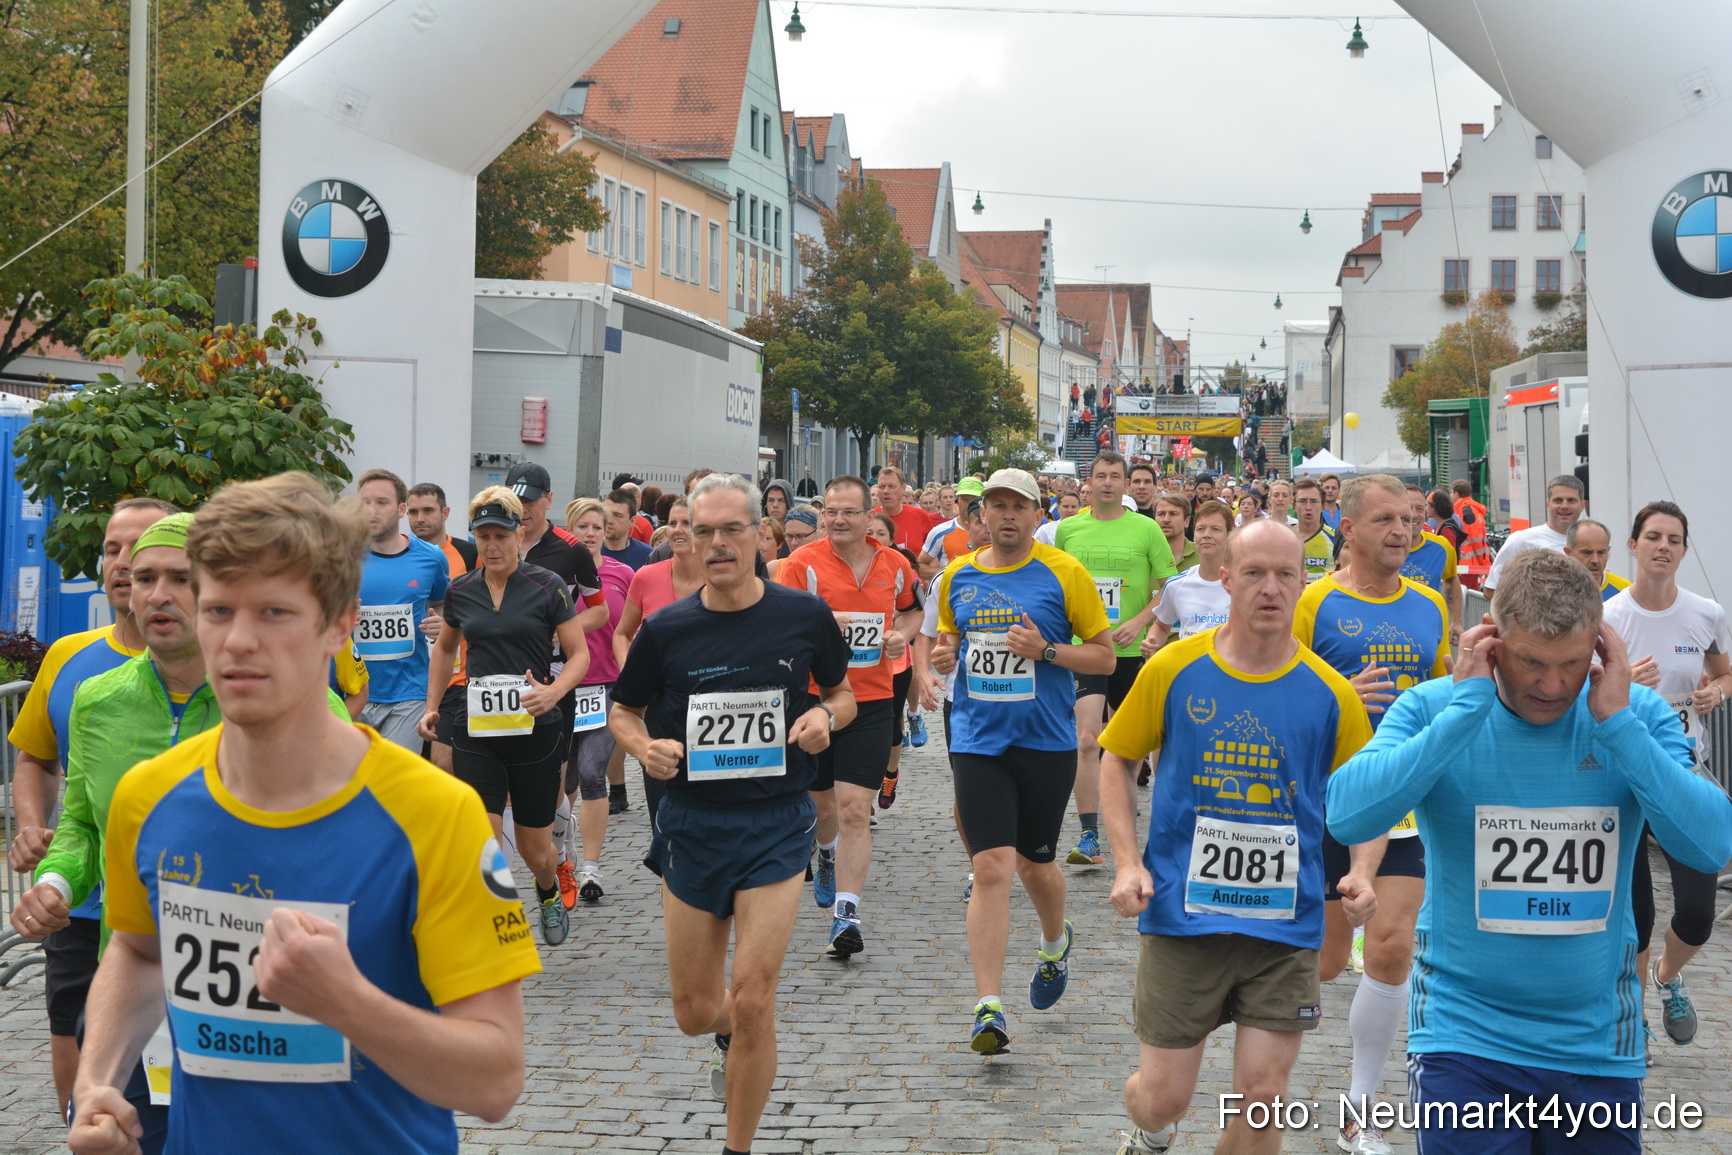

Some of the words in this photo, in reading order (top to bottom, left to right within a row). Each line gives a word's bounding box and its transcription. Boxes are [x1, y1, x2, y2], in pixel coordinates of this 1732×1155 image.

[289, 182, 382, 222] BMW
[726, 383, 755, 426] BOCK
[1156, 420, 1200, 431] START
[1304, 558, 1325, 566] CK
[360, 618, 409, 640] 3386
[971, 648, 1027, 675] 2872
[981, 680, 1013, 692] Robert
[481, 688, 520, 712] 610
[690, 702, 721, 711] PARTL
[723, 701, 768, 710] Neumarkt
[1192, 706, 1210, 714] Jahre
[697, 712, 776, 746] 2276
[714, 754, 760, 767] Werner
[1204, 767, 1258, 779] 21.September
[1479, 818, 1527, 831] PARTL
[1530, 819, 1597, 832] Neumarkt
[1197, 826, 1229, 841] PARTL
[1231, 832, 1282, 845] Neumarkt
[172, 856, 185, 866] 15
[1200, 843, 1285, 883] 2081
[1491, 836, 1606, 884] 2240
[163, 870, 191, 882] Jahre
[1212, 889, 1270, 906] Andreas
[1527, 897, 1571, 916] Felix
[163, 901, 215, 927] PARTL
[197, 1022, 288, 1057] Sascha
